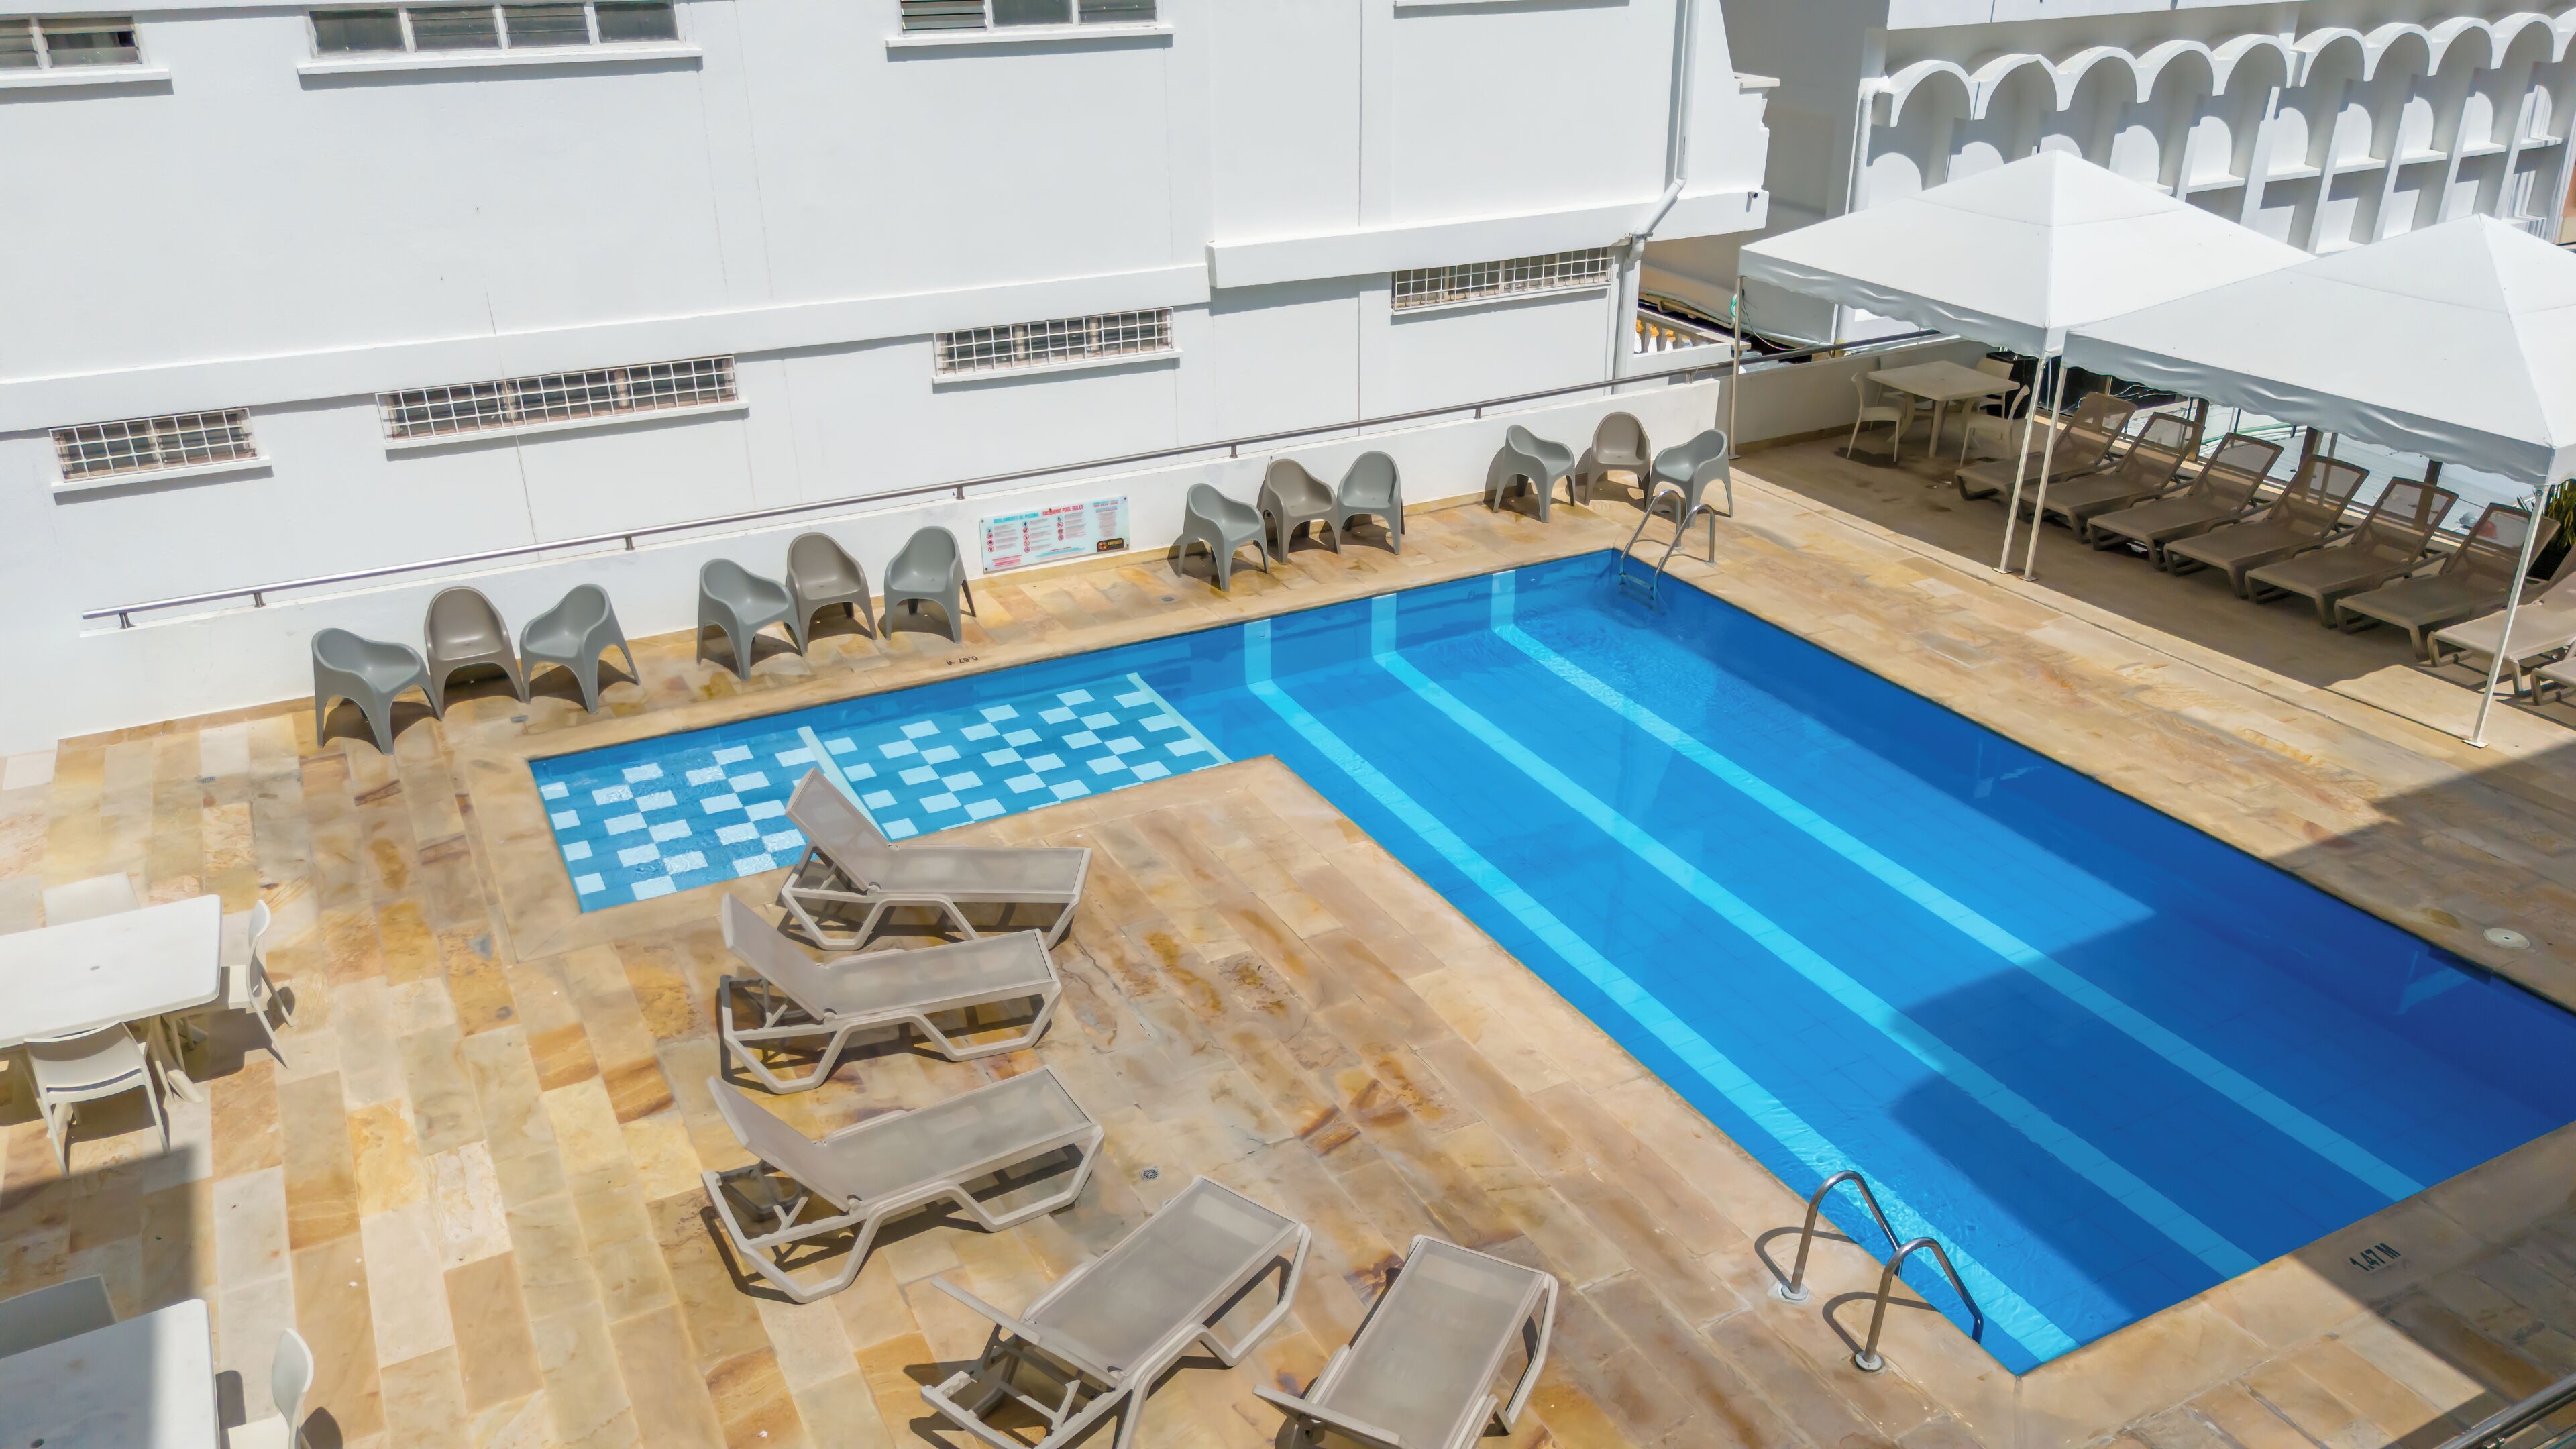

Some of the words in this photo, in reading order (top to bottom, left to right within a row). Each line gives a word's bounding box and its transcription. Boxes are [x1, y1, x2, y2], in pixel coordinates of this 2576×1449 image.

[959, 656, 979, 664] 0.67
[2349, 1248, 2386, 1271] 1.47
[2374, 1242, 2402, 1260] M
